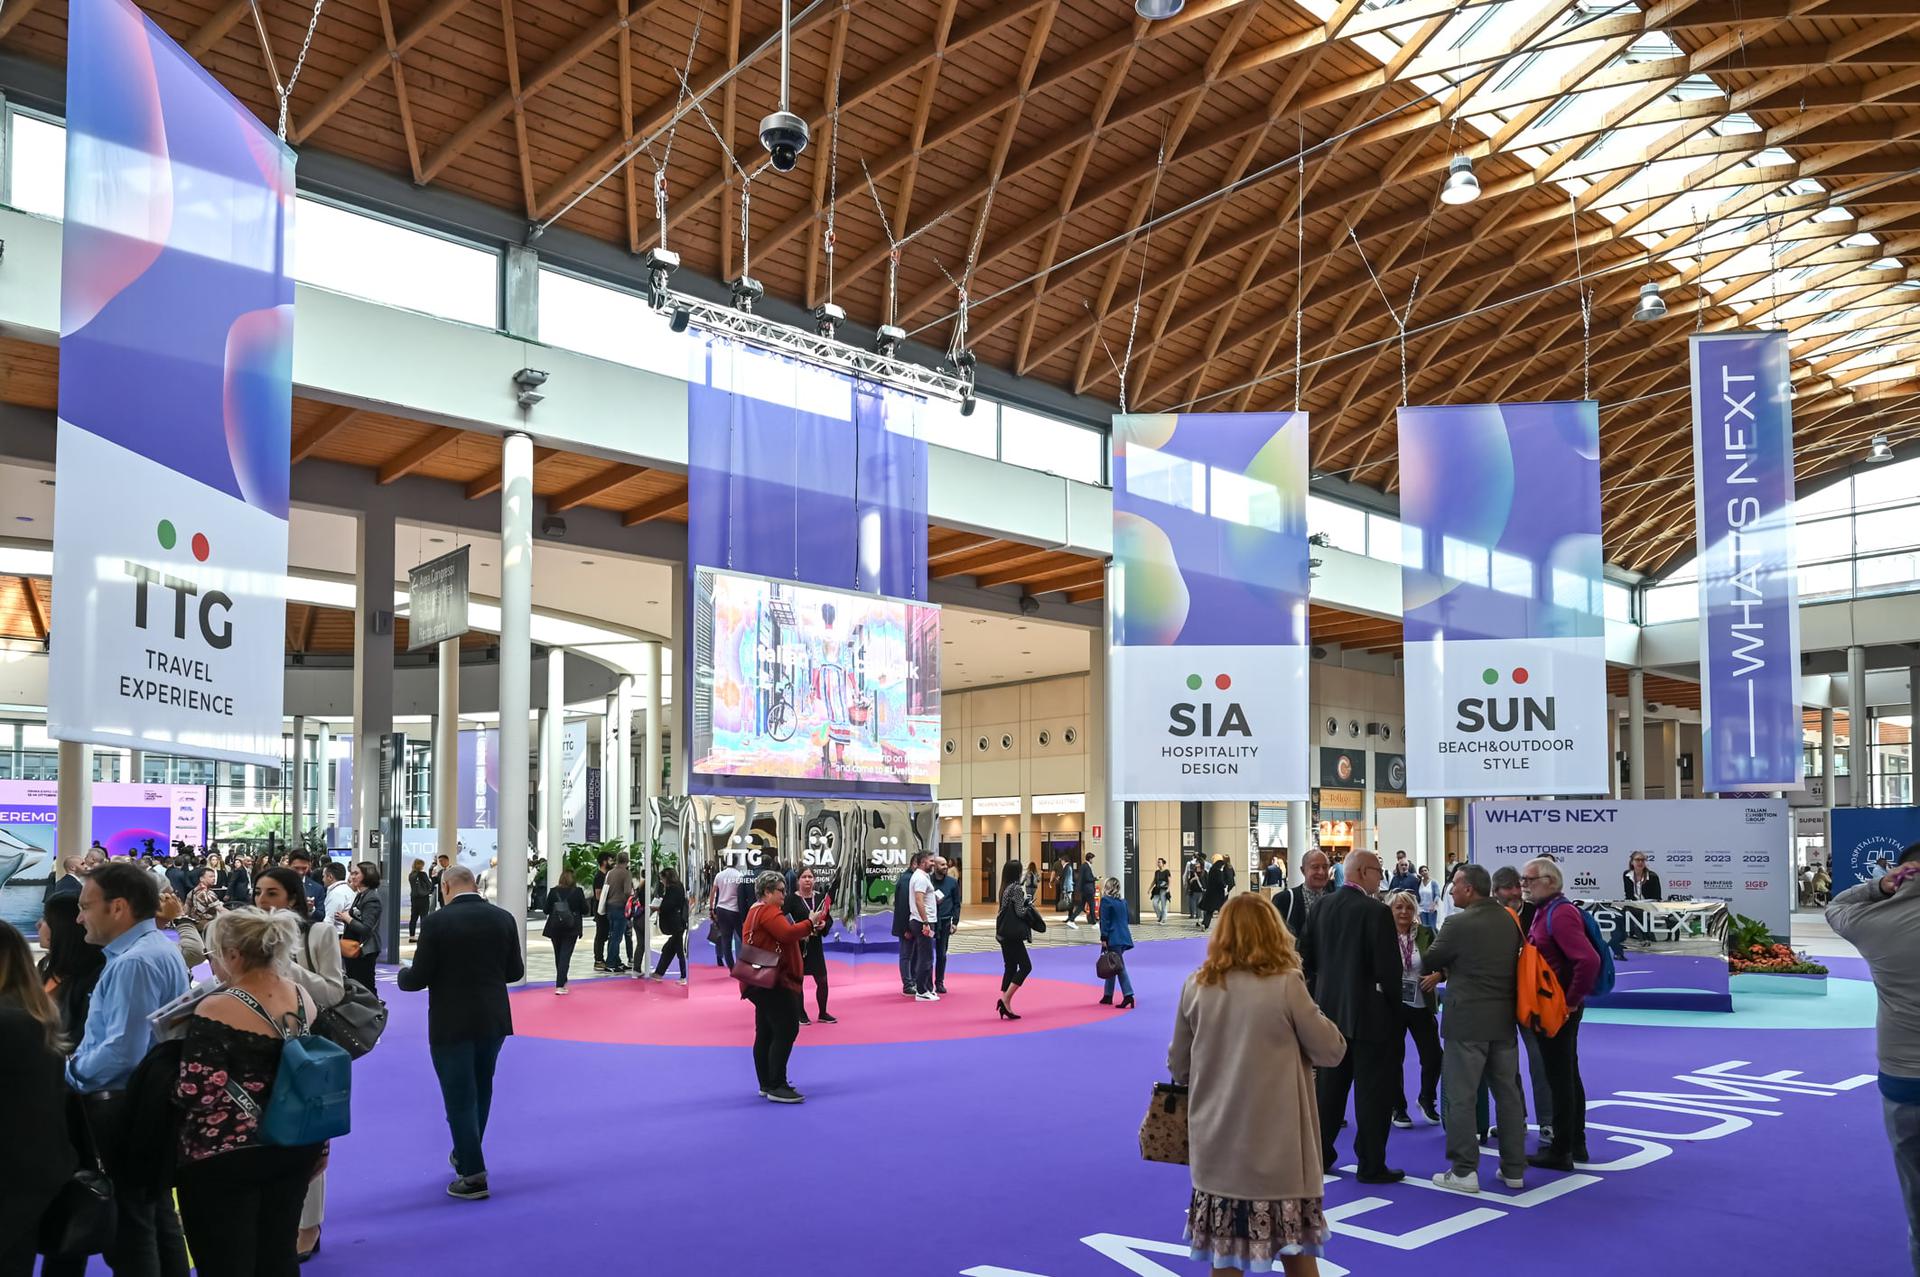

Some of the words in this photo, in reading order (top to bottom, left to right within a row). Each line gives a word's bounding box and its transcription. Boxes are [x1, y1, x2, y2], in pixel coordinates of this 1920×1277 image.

[1721, 365, 1760, 484] NEXT
[1727, 496, 1766, 677] WHAT'S
[124, 559, 234, 650] TTG
[145, 649, 214, 683] TRAVEL
[120, 675, 234, 716] EXPERIENCE
[1167, 702, 1253, 738] SIA
[1456, 696, 1556, 733] SUN
[1161, 745, 1259, 758] HOSPITALITY
[1438, 738, 1574, 754] BEACH&OUTDOOR
[1181, 762, 1239, 775] DESIGN
[1483, 757, 1530, 770] STYLE
[0, 811, 56, 822] EREMO
[1485, 809, 1561, 824] WHAT'S
[1566, 809, 1618, 823] NEXT
[722, 849, 762, 866] TTG
[803, 848, 836, 866] SIA
[871, 849, 907, 865] SUN
[1495, 846, 1517, 854] 11-13
[1520, 845, 1574, 854] OTTOBRE
[1576, 845, 1609, 854] 2023
[1574, 878, 1597, 886] SUN
[1625, 910, 1715, 933] NEXT
